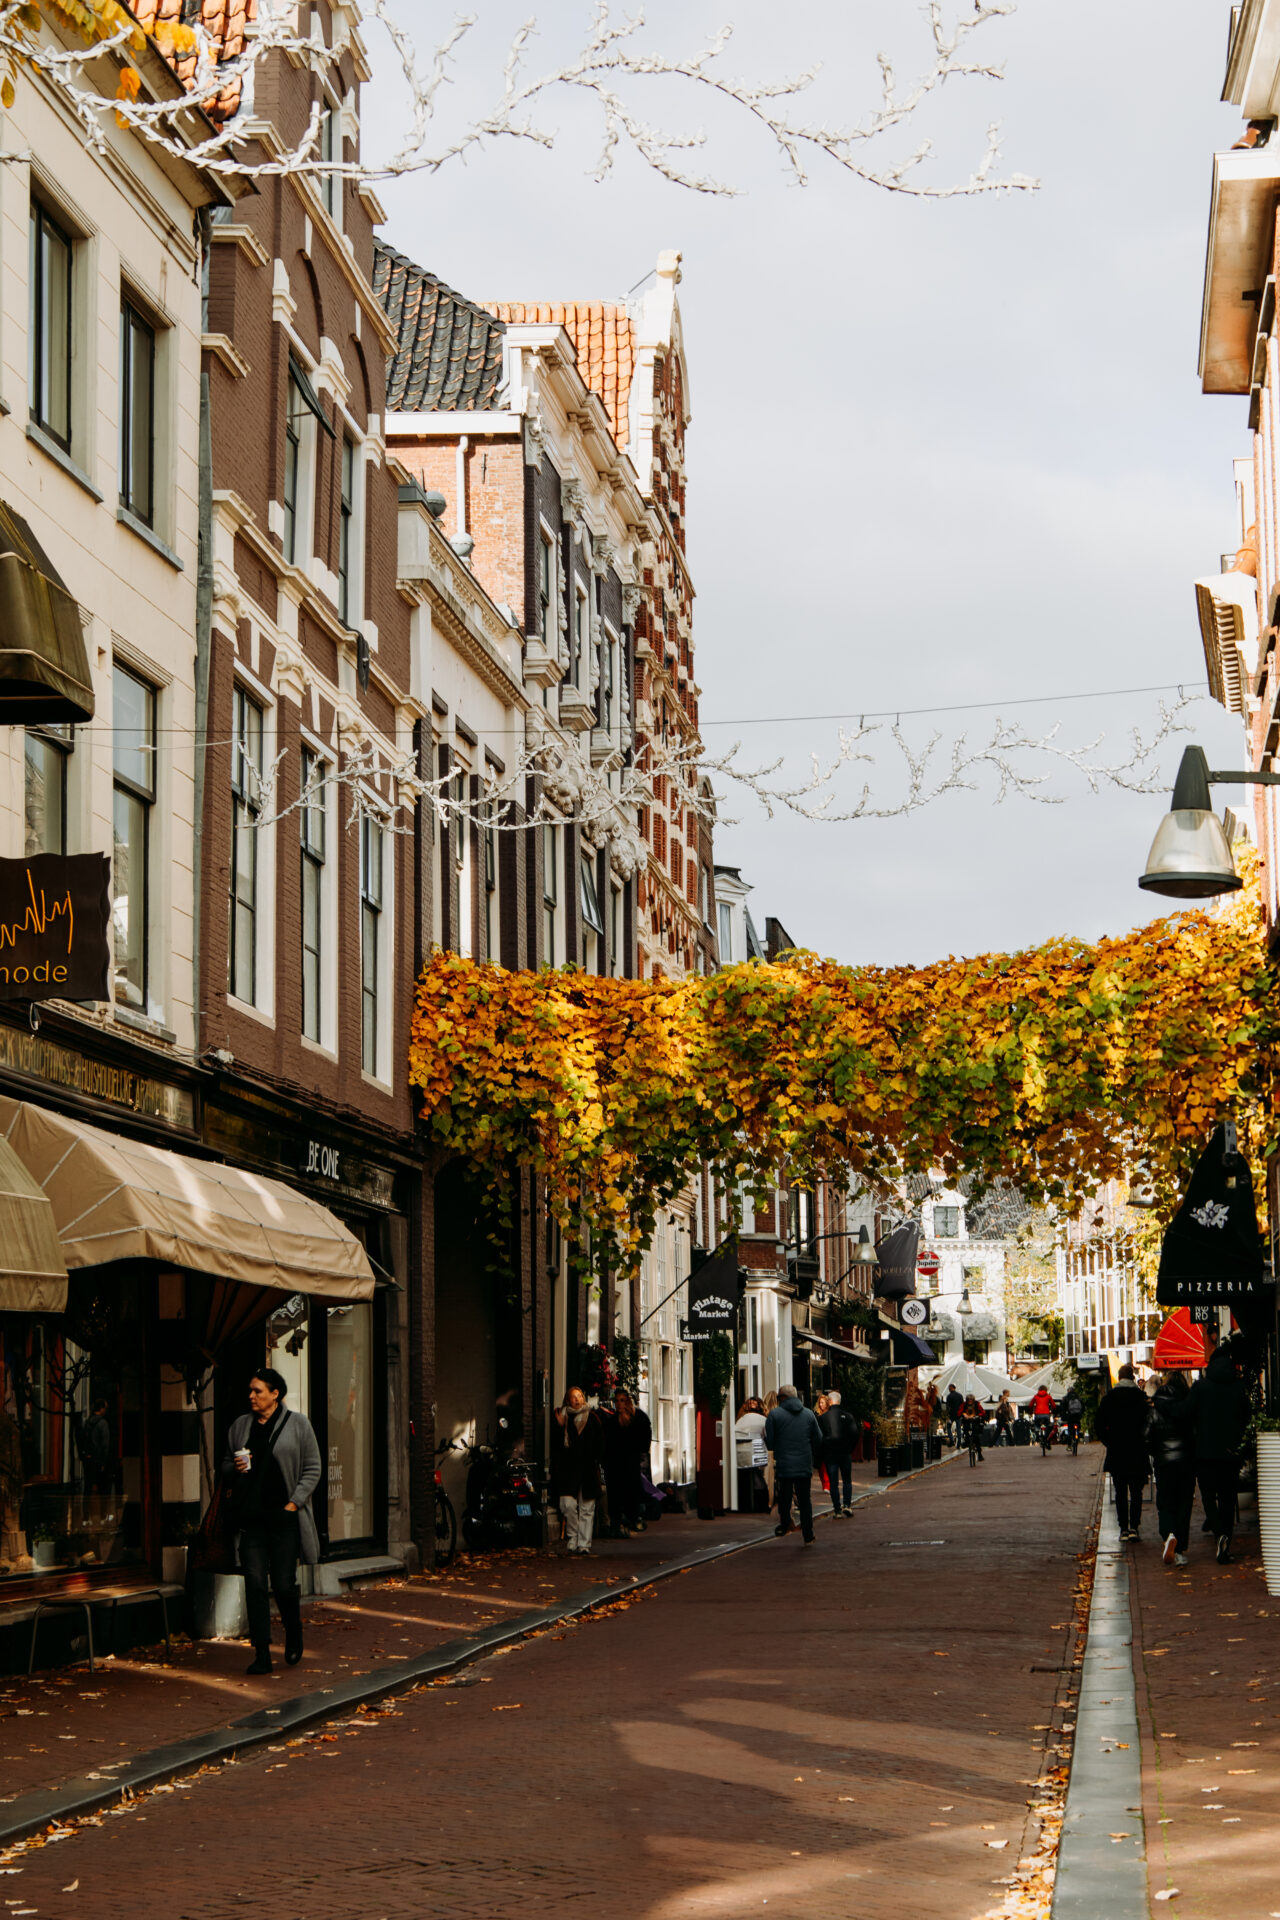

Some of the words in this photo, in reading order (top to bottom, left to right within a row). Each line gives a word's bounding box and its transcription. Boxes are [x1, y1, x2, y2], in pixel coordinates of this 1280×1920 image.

[308, 1140, 320, 1173] BE
[320, 1145, 340, 1180] ONE
[1177, 1281, 1254, 1292] PIZZERIA
[692, 1294, 734, 1312] Vintage
[699, 1310, 729, 1318] Market
[683, 1332, 710, 1341] Market
